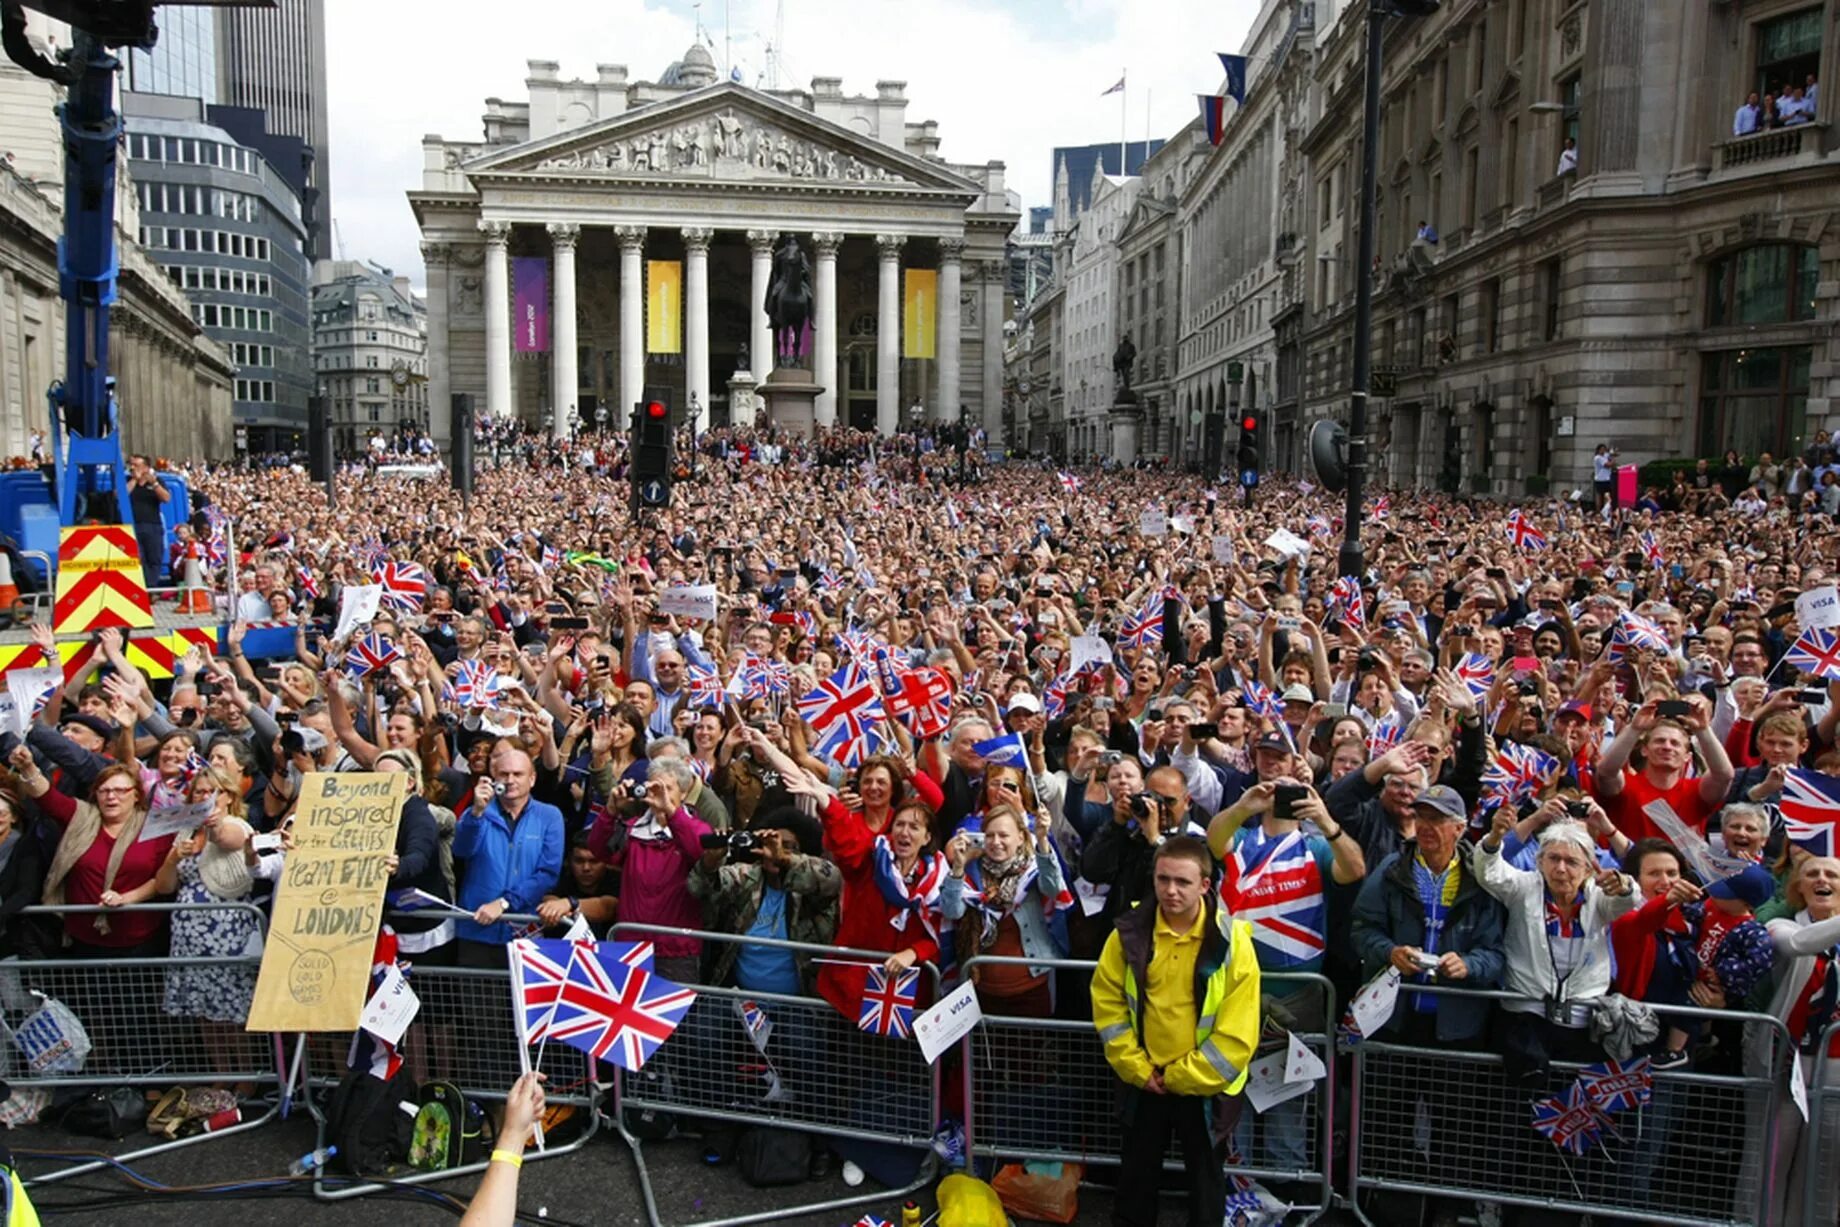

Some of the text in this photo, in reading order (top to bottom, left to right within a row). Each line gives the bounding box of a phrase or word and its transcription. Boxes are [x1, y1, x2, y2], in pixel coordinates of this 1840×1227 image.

[1810, 596, 1835, 609] VISA
[0, 702, 15, 712] SA
[321, 774, 396, 804] Beyond
[310, 796, 397, 829] inspired
[1697, 921, 1725, 963] GREAT
[392, 977, 407, 996] VIS
[949, 995, 972, 1016] VISA
